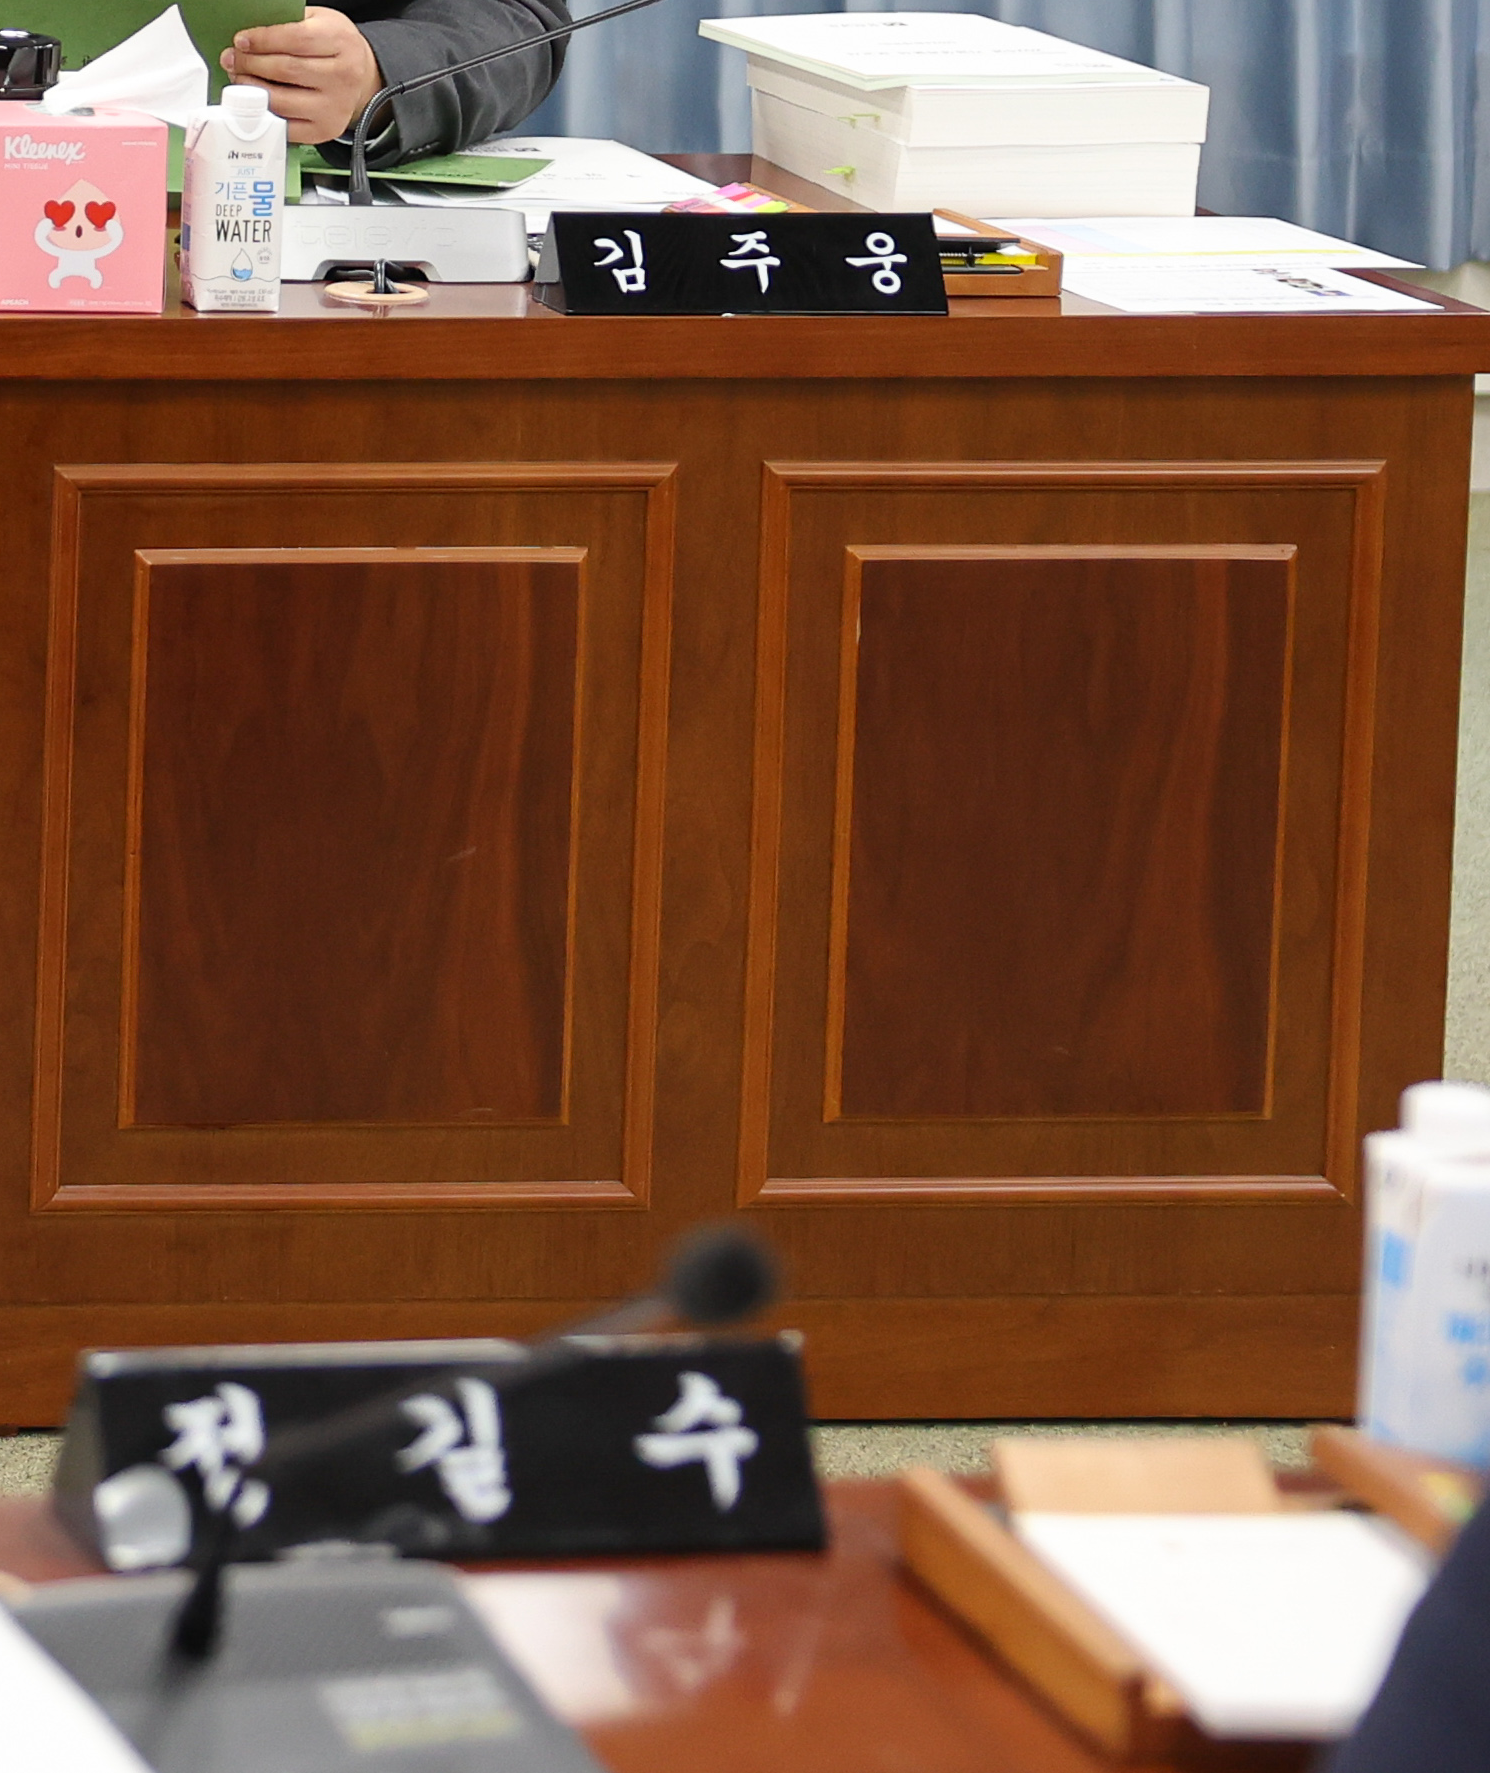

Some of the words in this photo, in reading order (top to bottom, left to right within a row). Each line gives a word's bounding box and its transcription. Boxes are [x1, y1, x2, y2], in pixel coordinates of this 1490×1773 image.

[4, 134, 86, 165] Kleenex
[215, 204, 242, 217] DEEP
[215, 219, 272, 243] WATER
[594, 230, 908, 294] 김주웅
